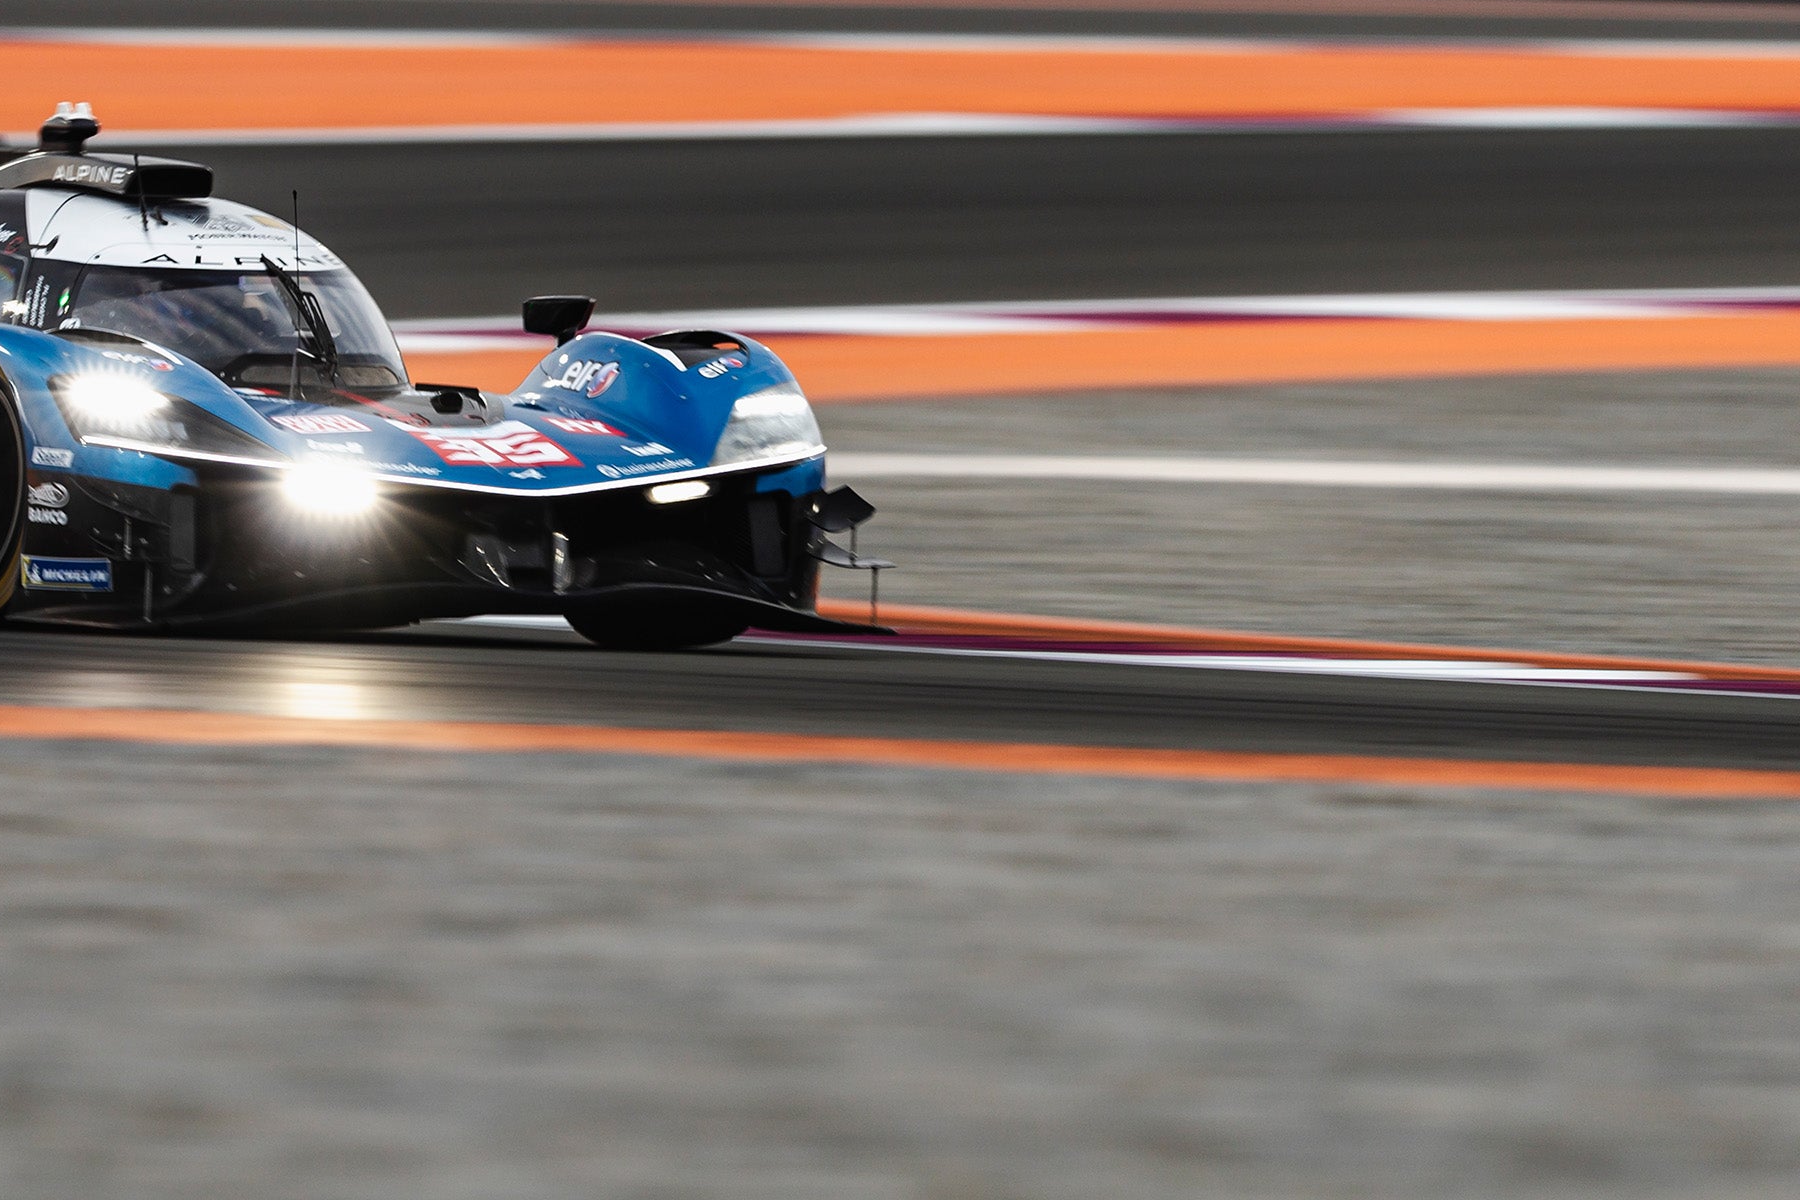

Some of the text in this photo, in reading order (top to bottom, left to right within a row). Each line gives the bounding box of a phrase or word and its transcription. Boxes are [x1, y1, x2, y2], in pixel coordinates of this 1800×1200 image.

[52, 164, 127, 185] ALPINE
[141, 253, 342, 267] ALPINE
[561, 360, 602, 391] elf
[698, 360, 729, 378] elf
[550, 418, 612, 434] HY
[430, 433, 571, 464] 35
[42, 569, 107, 583] MICHELIN
